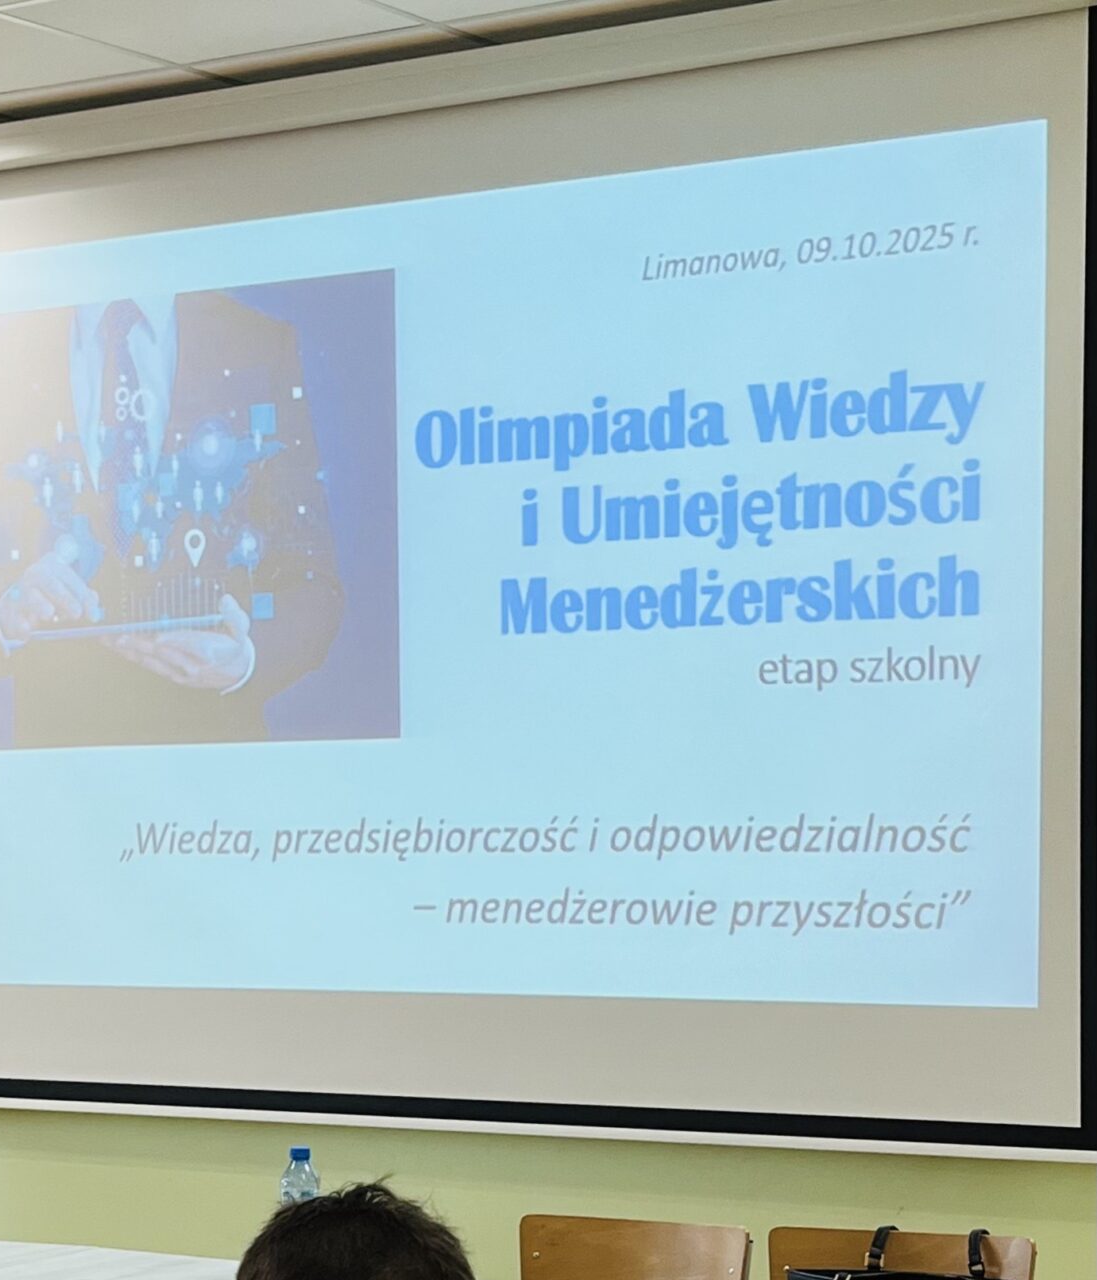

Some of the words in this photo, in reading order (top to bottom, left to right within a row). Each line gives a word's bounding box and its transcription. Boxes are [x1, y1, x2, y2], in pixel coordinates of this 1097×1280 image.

[642, 246, 788, 282] Limanowa,
[796, 221, 955, 265] 09.10.2025
[962, 224, 980, 247] r.
[415, 388, 730, 472] Olimpiada
[747, 369, 986, 445] Wiedzy
[521, 488, 538, 547] i
[562, 458, 981, 550] Umiejętności
[500, 554, 980, 636] Menedżerskich
[758, 653, 838, 692] etap
[849, 645, 982, 688] szkolny
[272, 815, 580, 863] przedsiębiorczość
[588, 817, 601, 853] i
[609, 812, 972, 861] odpowiedzialność
[445, 887, 717, 927] menedżerowie
